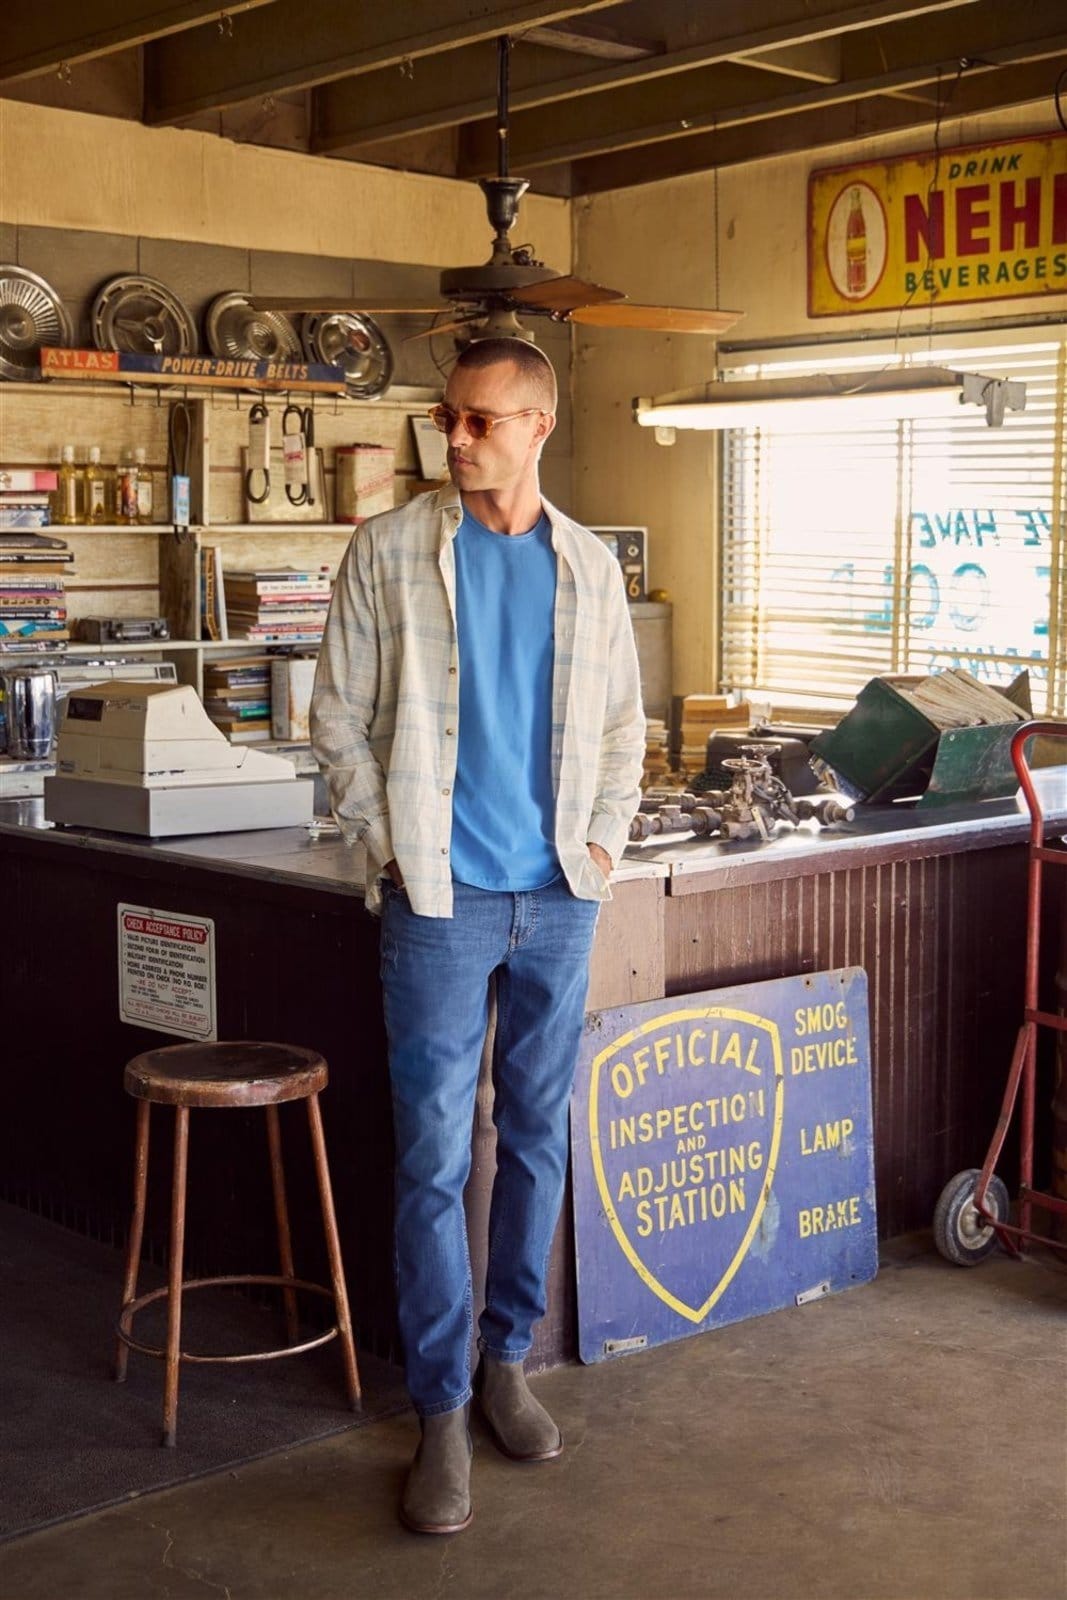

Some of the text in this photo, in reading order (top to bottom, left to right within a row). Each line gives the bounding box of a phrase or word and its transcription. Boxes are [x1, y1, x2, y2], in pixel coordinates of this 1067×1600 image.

[949, 155, 1022, 179] DRINK
[905, 253, 1067, 293] BEVERAGES
[45, 352, 113, 369] ATLAS
[266, 363, 309, 379] BELTS
[795, 1001, 847, 1036] SMOG
[611, 1029, 762, 1098] OFFICIAL
[791, 1037, 858, 1075] DEVICE
[610, 1089, 764, 1149] INSPECTION
[800, 1118, 854, 1155] LAMP
[676, 1135, 706, 1155] AND
[618, 1141, 762, 1202] ADJUSTING
[637, 1177, 746, 1237] STATION
[799, 1197, 861, 1239] BRAKE
